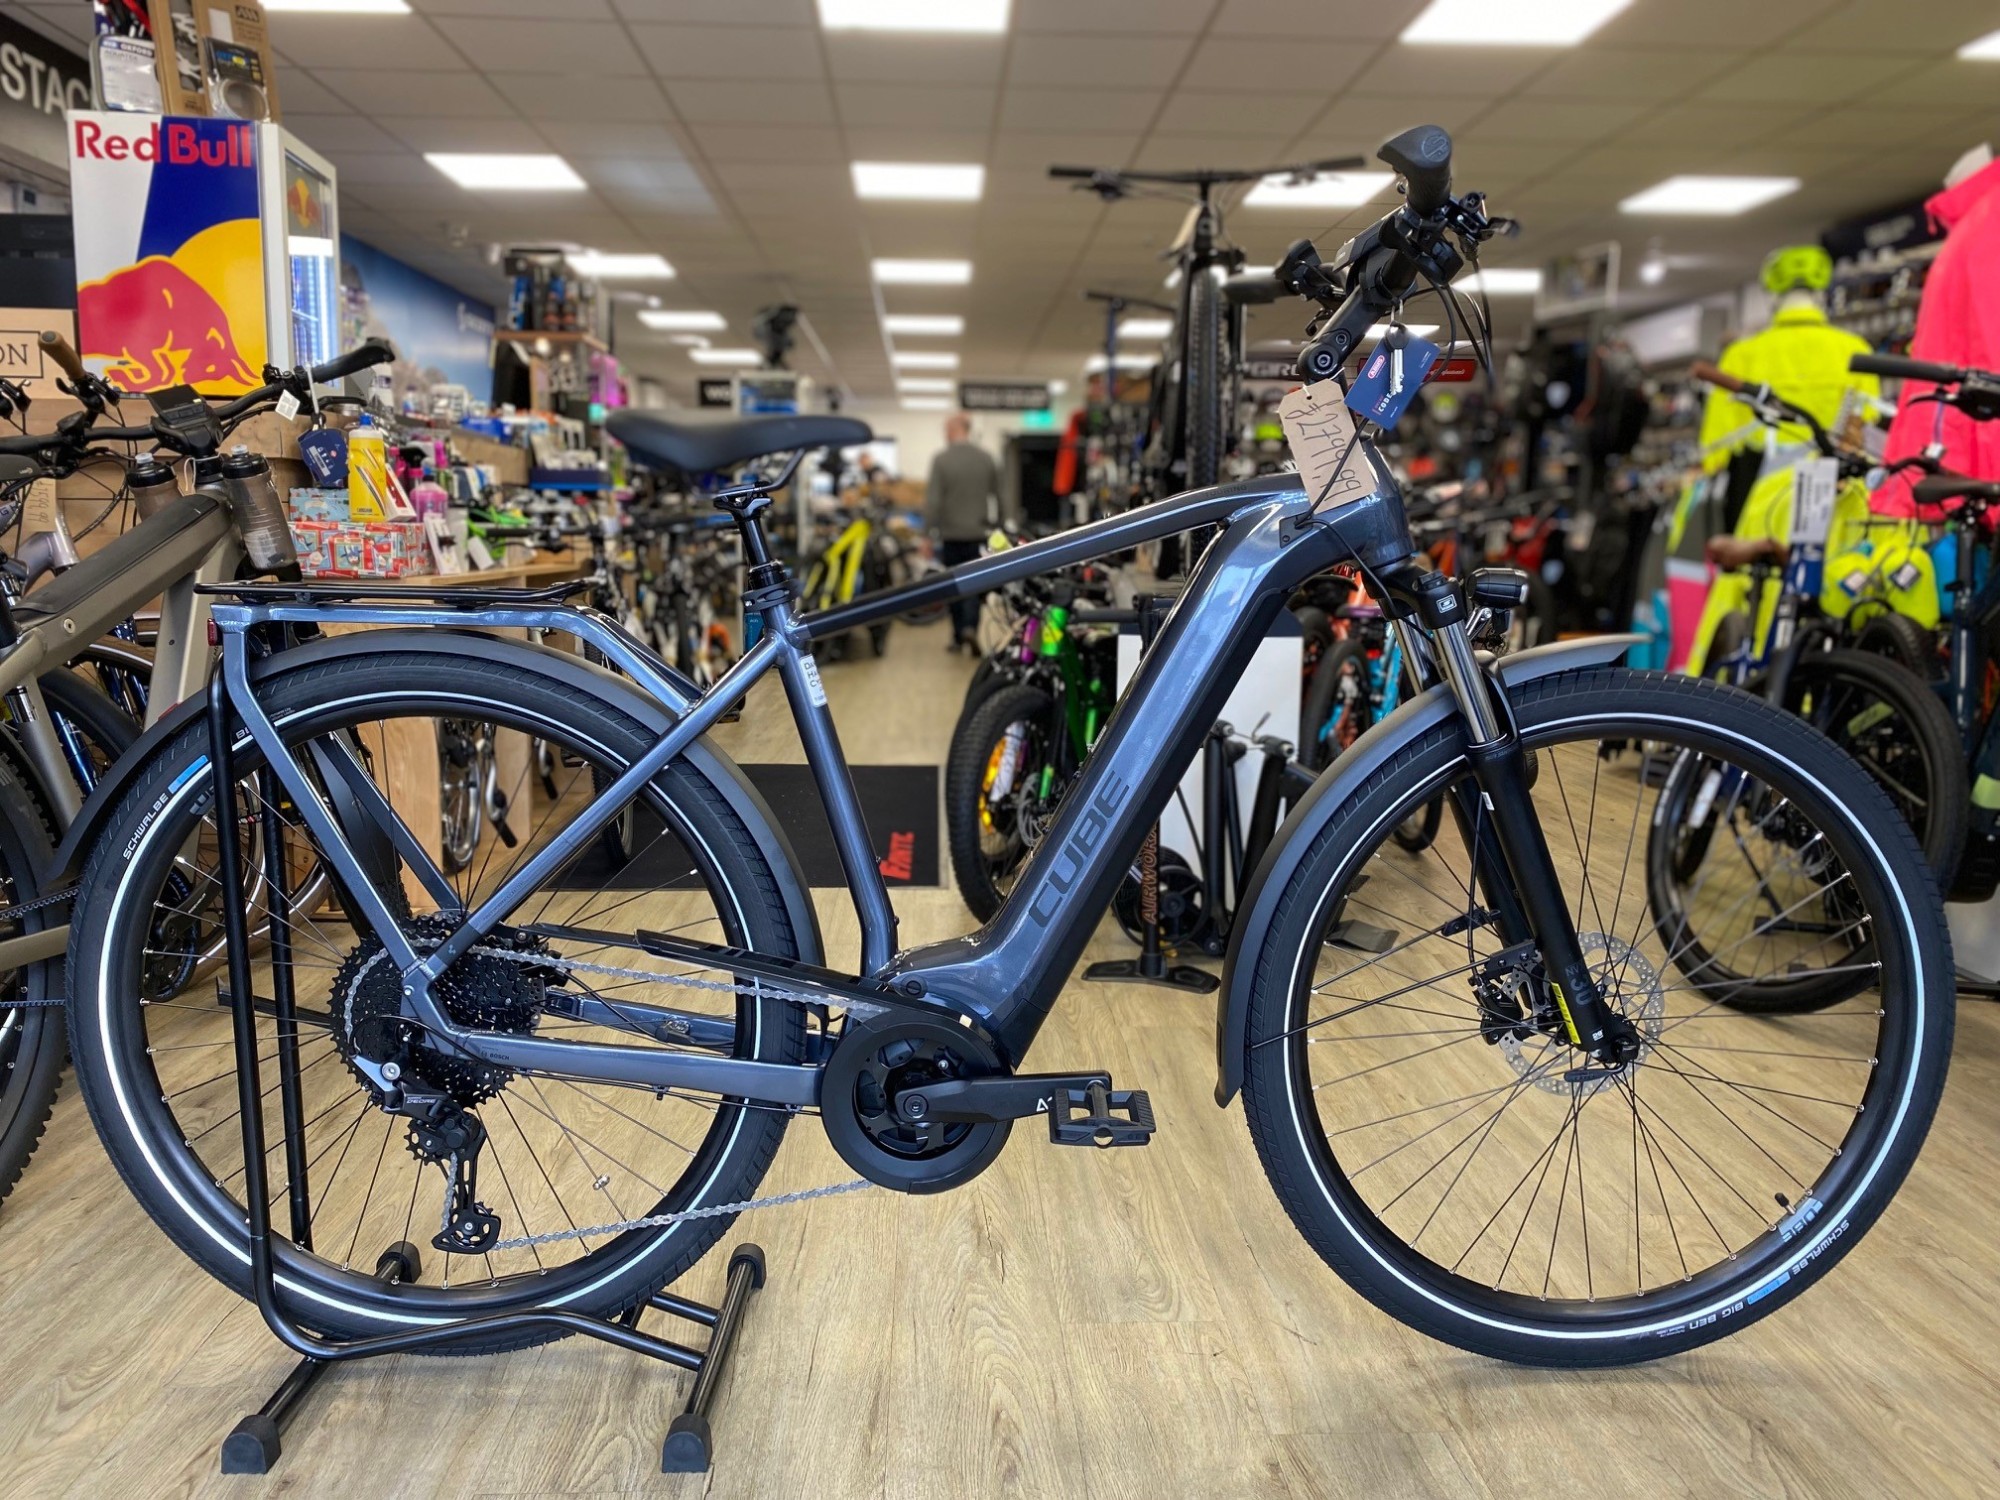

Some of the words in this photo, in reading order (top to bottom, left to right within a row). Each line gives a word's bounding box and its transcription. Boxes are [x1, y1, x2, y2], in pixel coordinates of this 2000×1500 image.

[75, 120, 161, 162] Red
[168, 123, 251, 167] Bull
[123, 793, 169, 860] SCHWALBE
[1029, 770, 1130, 928] CUBE
[1792, 1219, 1850, 1275] SCHWALBE
[1689, 1315, 1717, 1330] BEN
[1722, 1301, 1744, 1318] BIG
